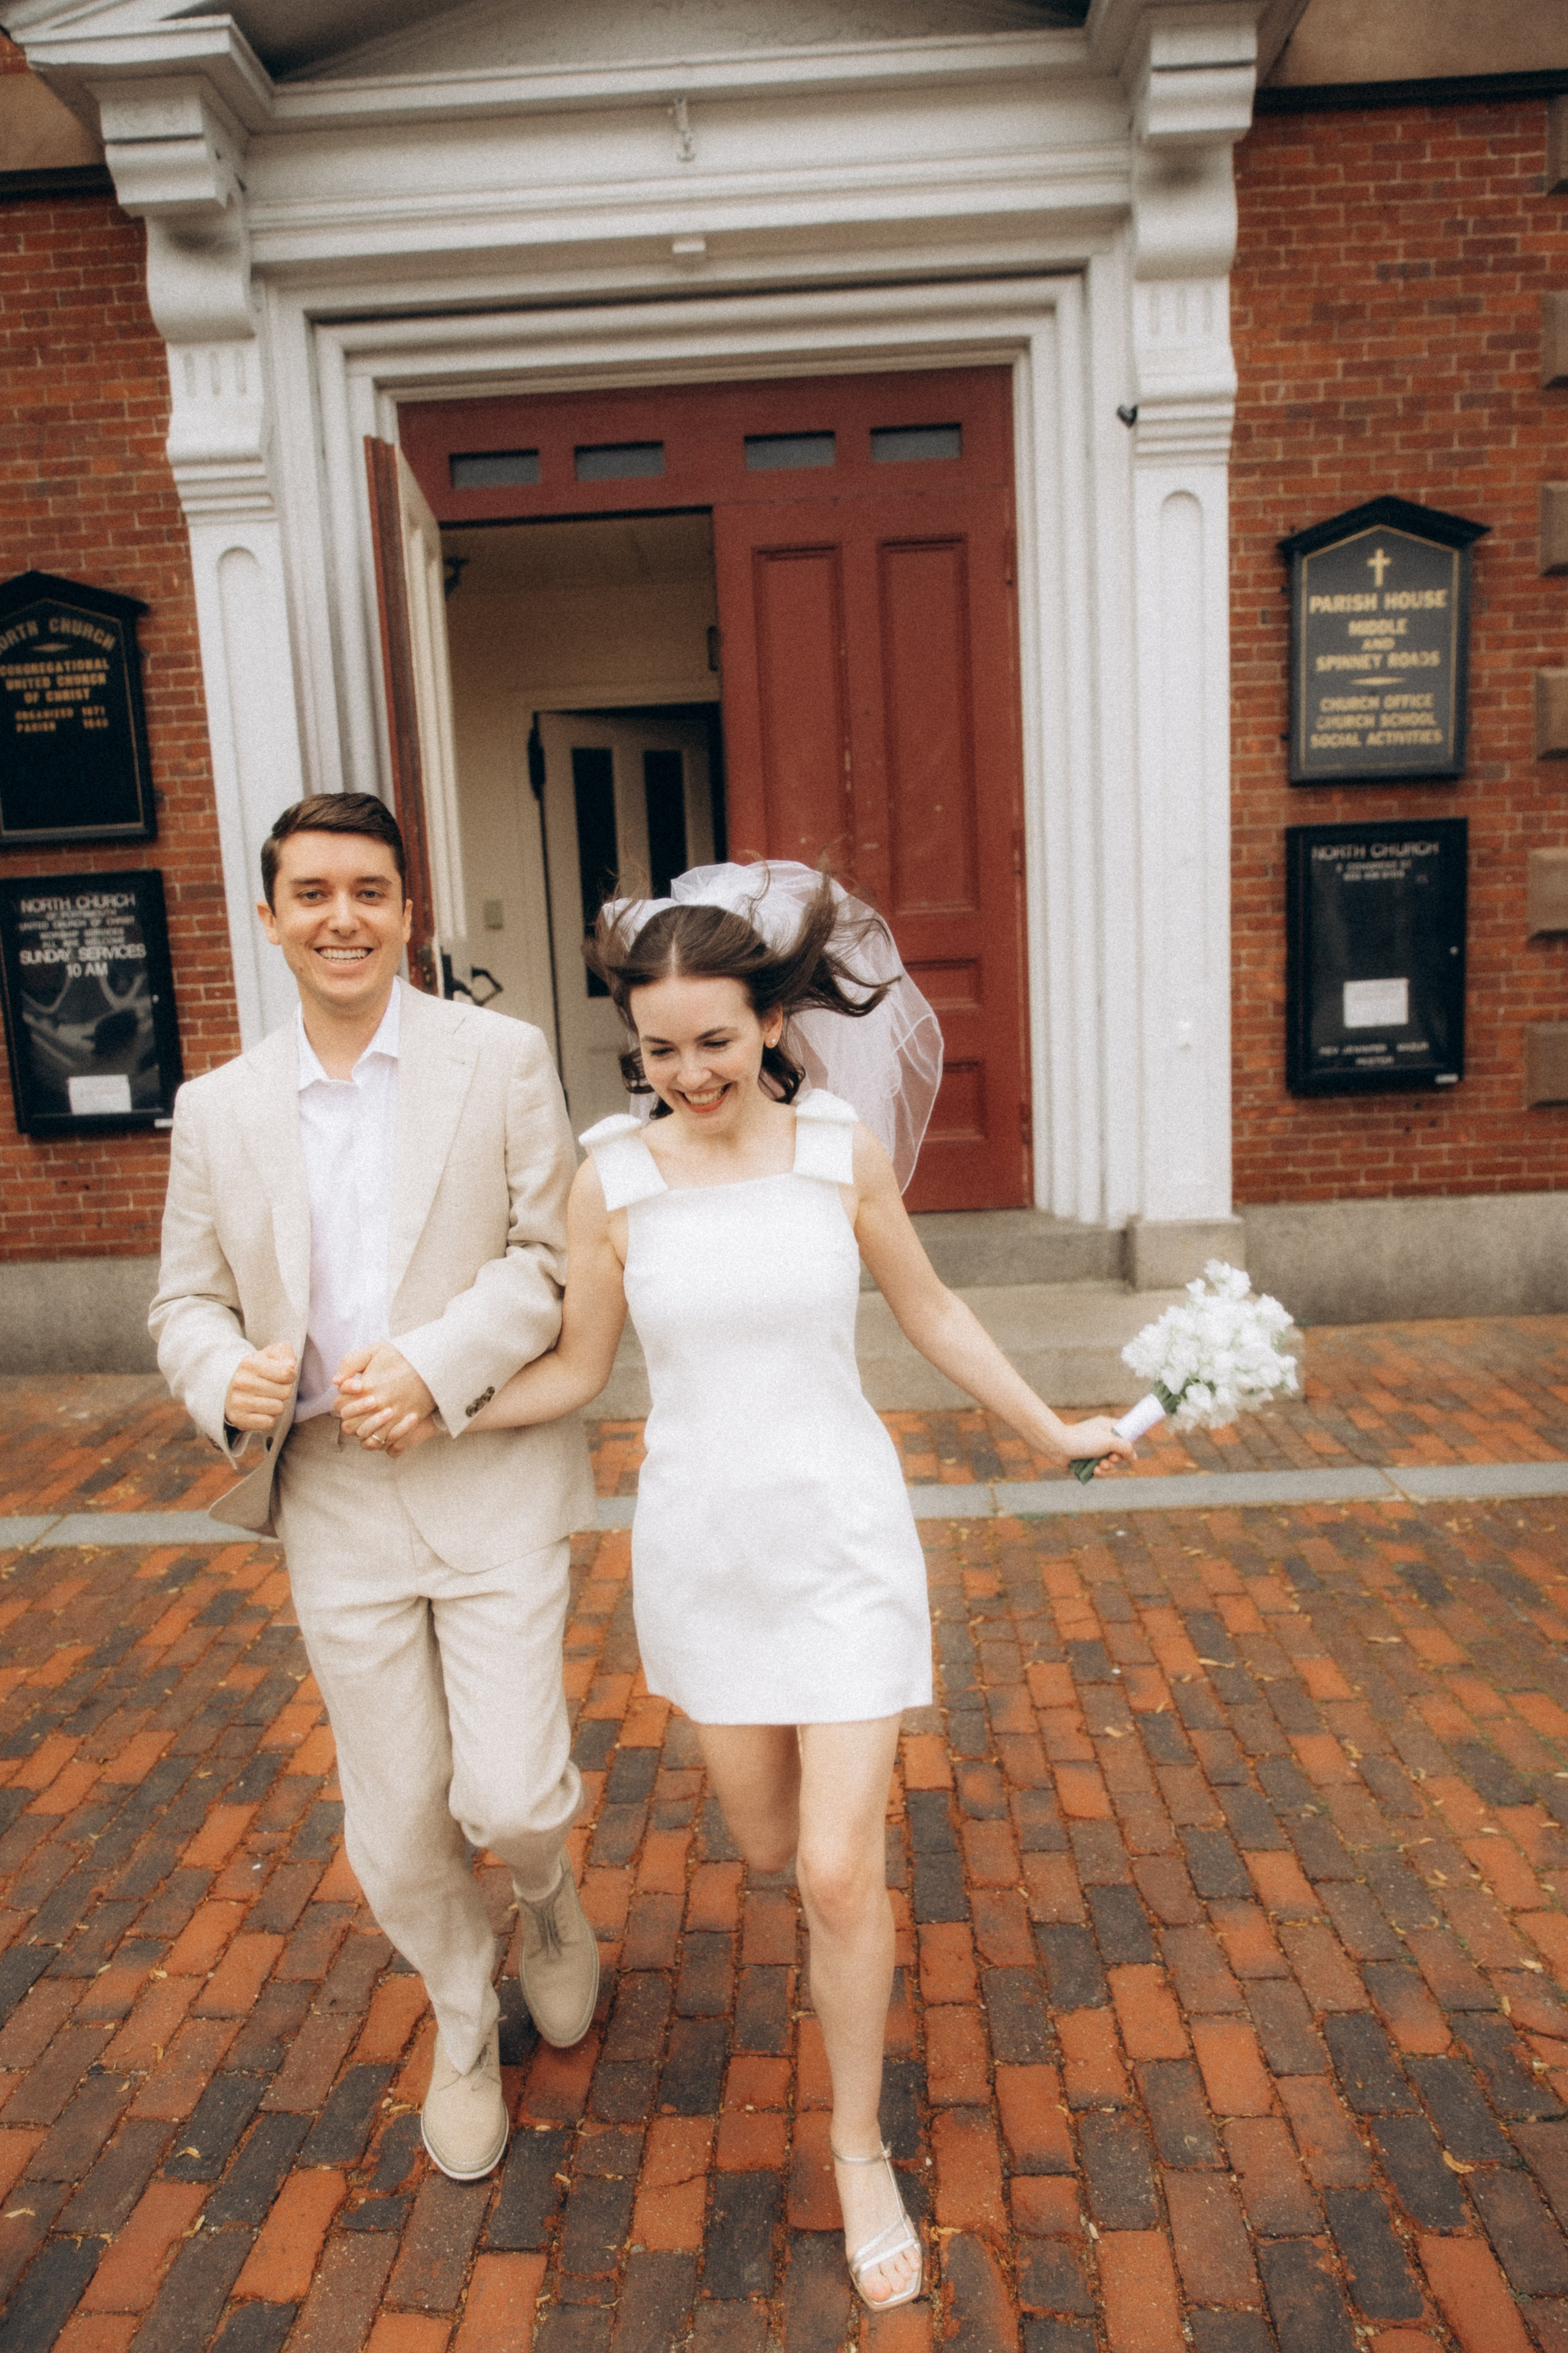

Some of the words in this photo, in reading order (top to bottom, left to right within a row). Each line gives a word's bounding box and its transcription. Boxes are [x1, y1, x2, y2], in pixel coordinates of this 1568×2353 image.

[1309, 592, 1378, 613] PARISH
[1384, 589, 1448, 610] HOUSE
[0, 620, 39, 655] ORTH
[49, 618, 115, 651] CHURCH
[1348, 618, 1408, 636] MIDDLE
[1361, 637, 1395, 651] AND
[0, 658, 110, 676] CONGREGATIONAL
[1387, 650, 1441, 669] ROADS
[6, 676, 51, 690] UNITED
[56, 672, 107, 687] CHURCH
[24, 690, 39, 704] OF
[45, 687, 90, 702] CHRIST
[1320, 695, 1380, 712] CHURCH
[1383, 693, 1434, 710] OFFICE
[1315, 713, 1375, 731] CHURCH
[1379, 711, 1438, 728] SCHOOL
[1310, 732, 1362, 749] SOCIAL
[1365, 728, 1443, 746] ACTIVITIES
[1311, 844, 1366, 861] NORTH
[1370, 840, 1439, 859] CHURCH
[20, 897, 71, 913] NORTH
[75, 893, 136, 910] CHURCH
[52, 919, 86, 929] CHURCH
[19, 948, 72, 965] SUNDAY
[78, 943, 146, 962] SERVICES
[66, 962, 82, 978] 10
[85, 962, 108, 977] AM
